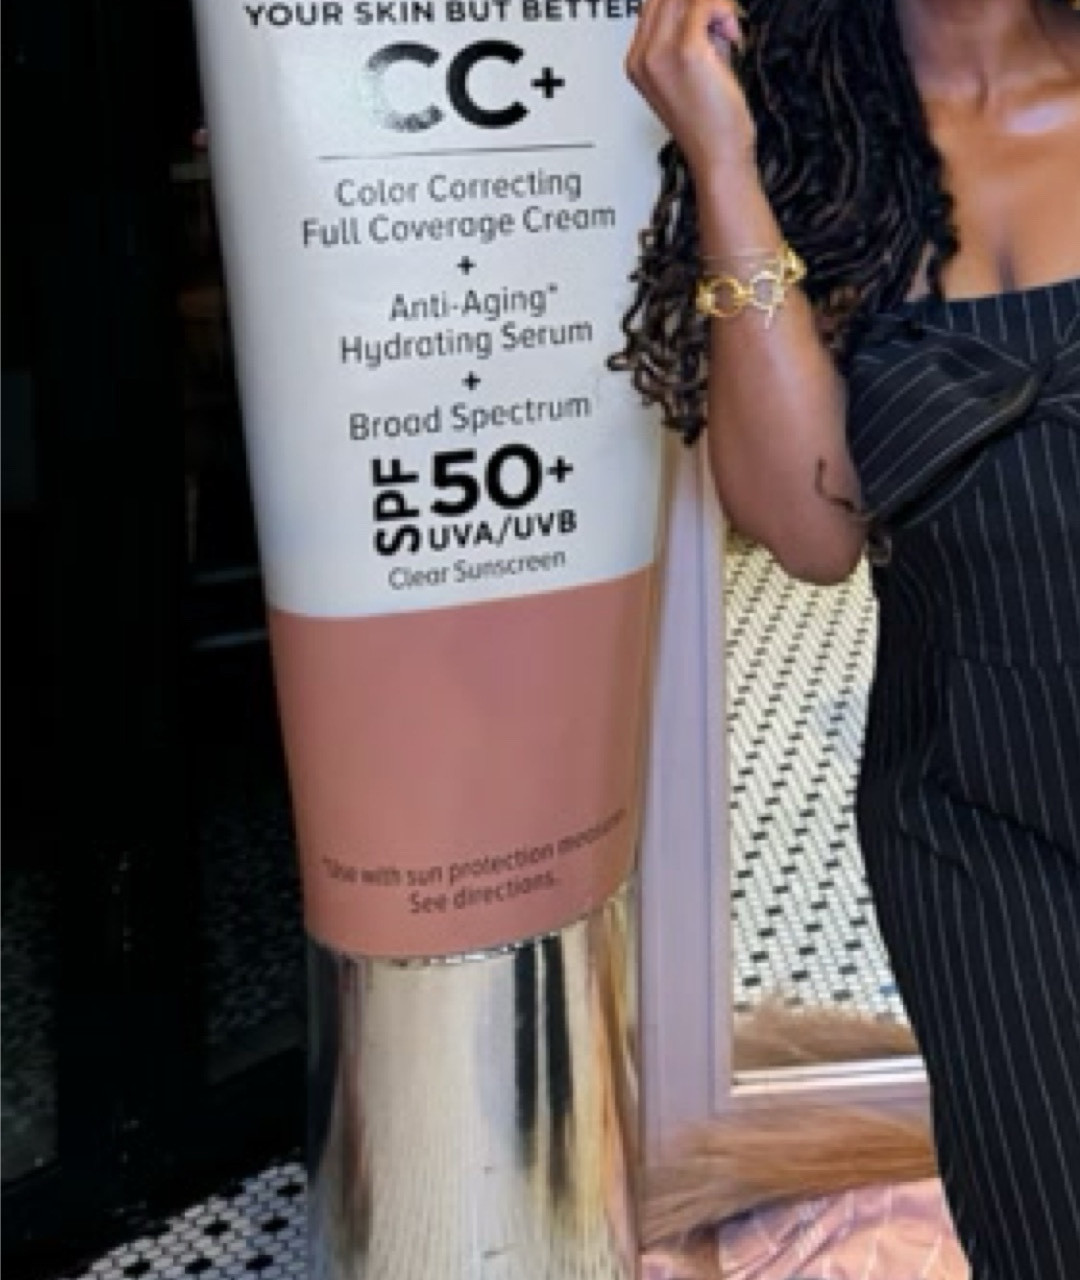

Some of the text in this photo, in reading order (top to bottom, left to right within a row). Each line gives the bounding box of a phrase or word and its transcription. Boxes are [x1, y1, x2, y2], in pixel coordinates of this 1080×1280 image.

[242, 1, 343, 28] YOUR
[354, 0, 436, 26] SKIN
[335, 169, 582, 207] Color Correcting
[302, 204, 617, 248] Full Coverage Cream
[340, 320, 594, 369] Hydrating Serum
[349, 395, 592, 441] Broad Spectrum
[430, 443, 574, 517] 50+
[370, 457, 420, 557] SPF
[429, 509, 578, 552] UVA/UVB
[387, 550, 567, 591] Clear Sunscreen
[407, 865, 443, 886] sun
[449, 842, 555, 885] protection
[407, 891, 447, 914] See
